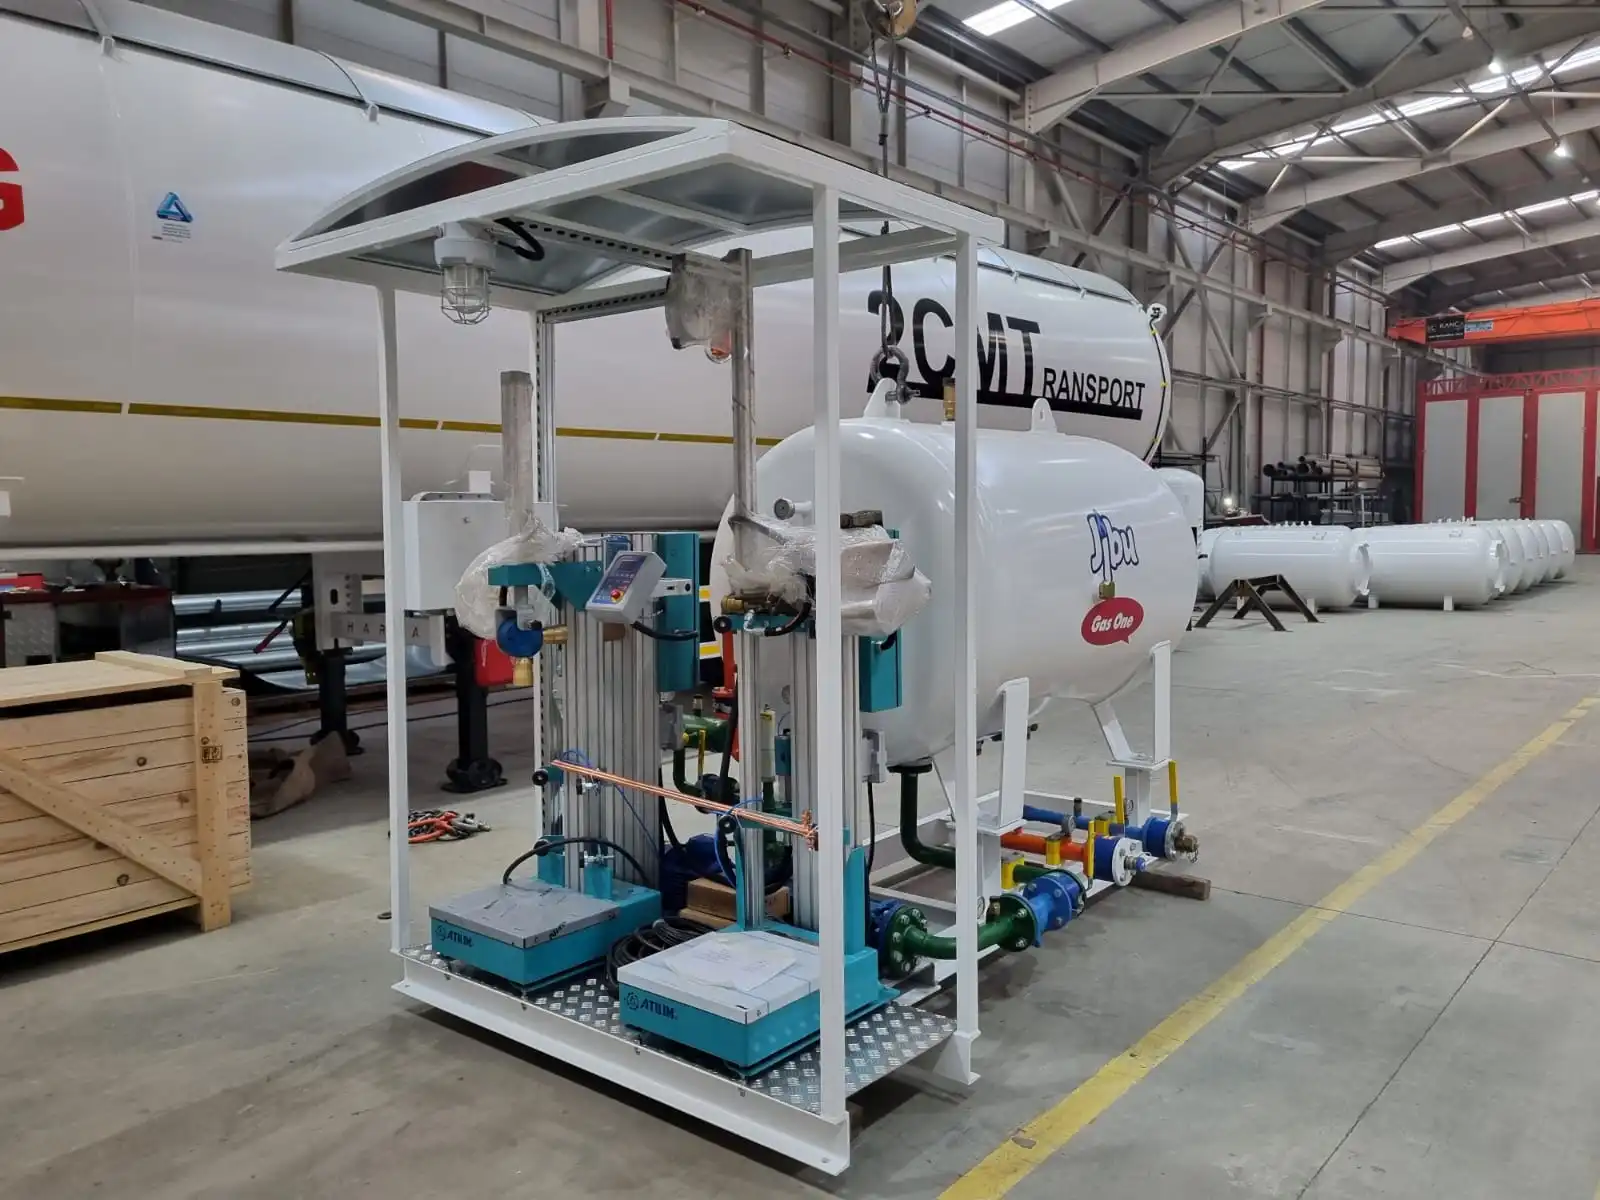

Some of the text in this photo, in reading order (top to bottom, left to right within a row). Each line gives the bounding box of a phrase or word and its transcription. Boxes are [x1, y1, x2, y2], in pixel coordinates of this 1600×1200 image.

[1043, 367, 1146, 410] RANSPORT
[1091, 612, 1134, 633] Gas One
